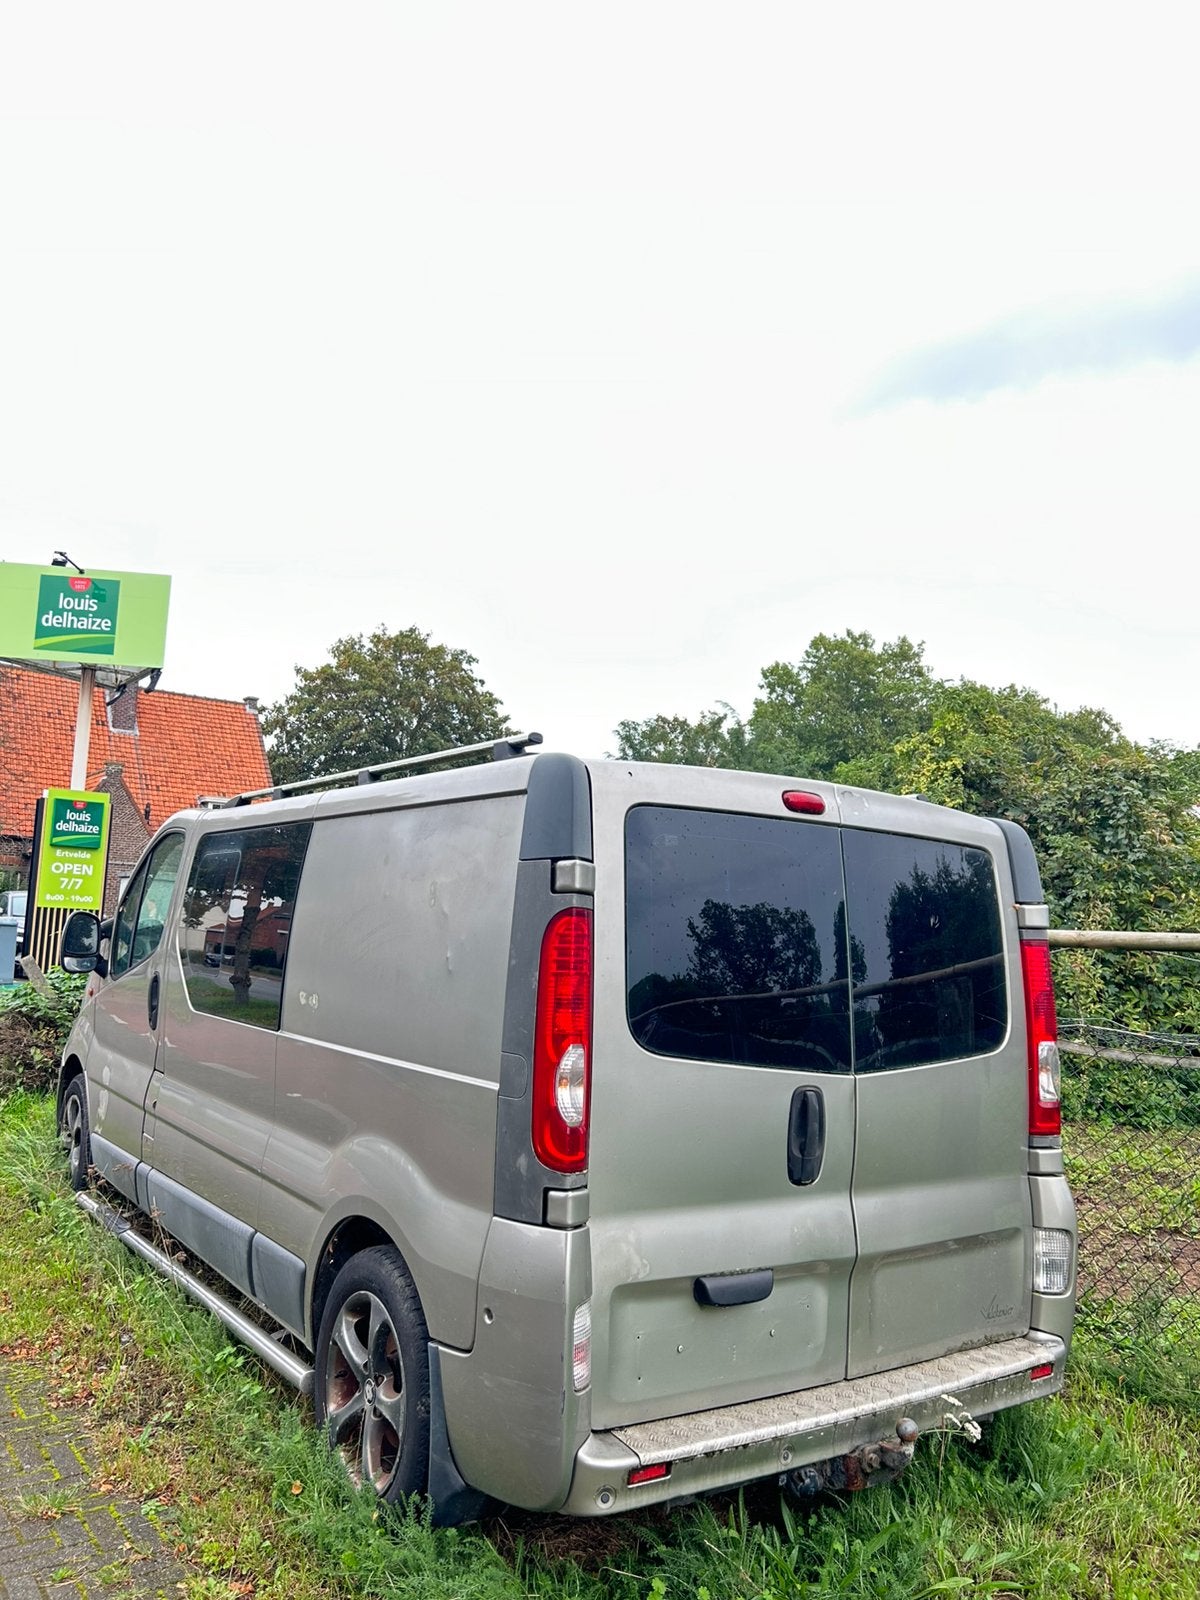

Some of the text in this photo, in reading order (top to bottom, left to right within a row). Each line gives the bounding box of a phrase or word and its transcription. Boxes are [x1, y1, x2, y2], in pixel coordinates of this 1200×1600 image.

[58, 592, 98, 611] louis
[41, 610, 112, 631] delhaize
[66, 809, 92, 822] louis
[55, 820, 100, 834] delhaize
[56, 850, 92, 859] Ertvelde
[51, 862, 94, 876] OPEN
[59, 878, 84, 890] 7/7
